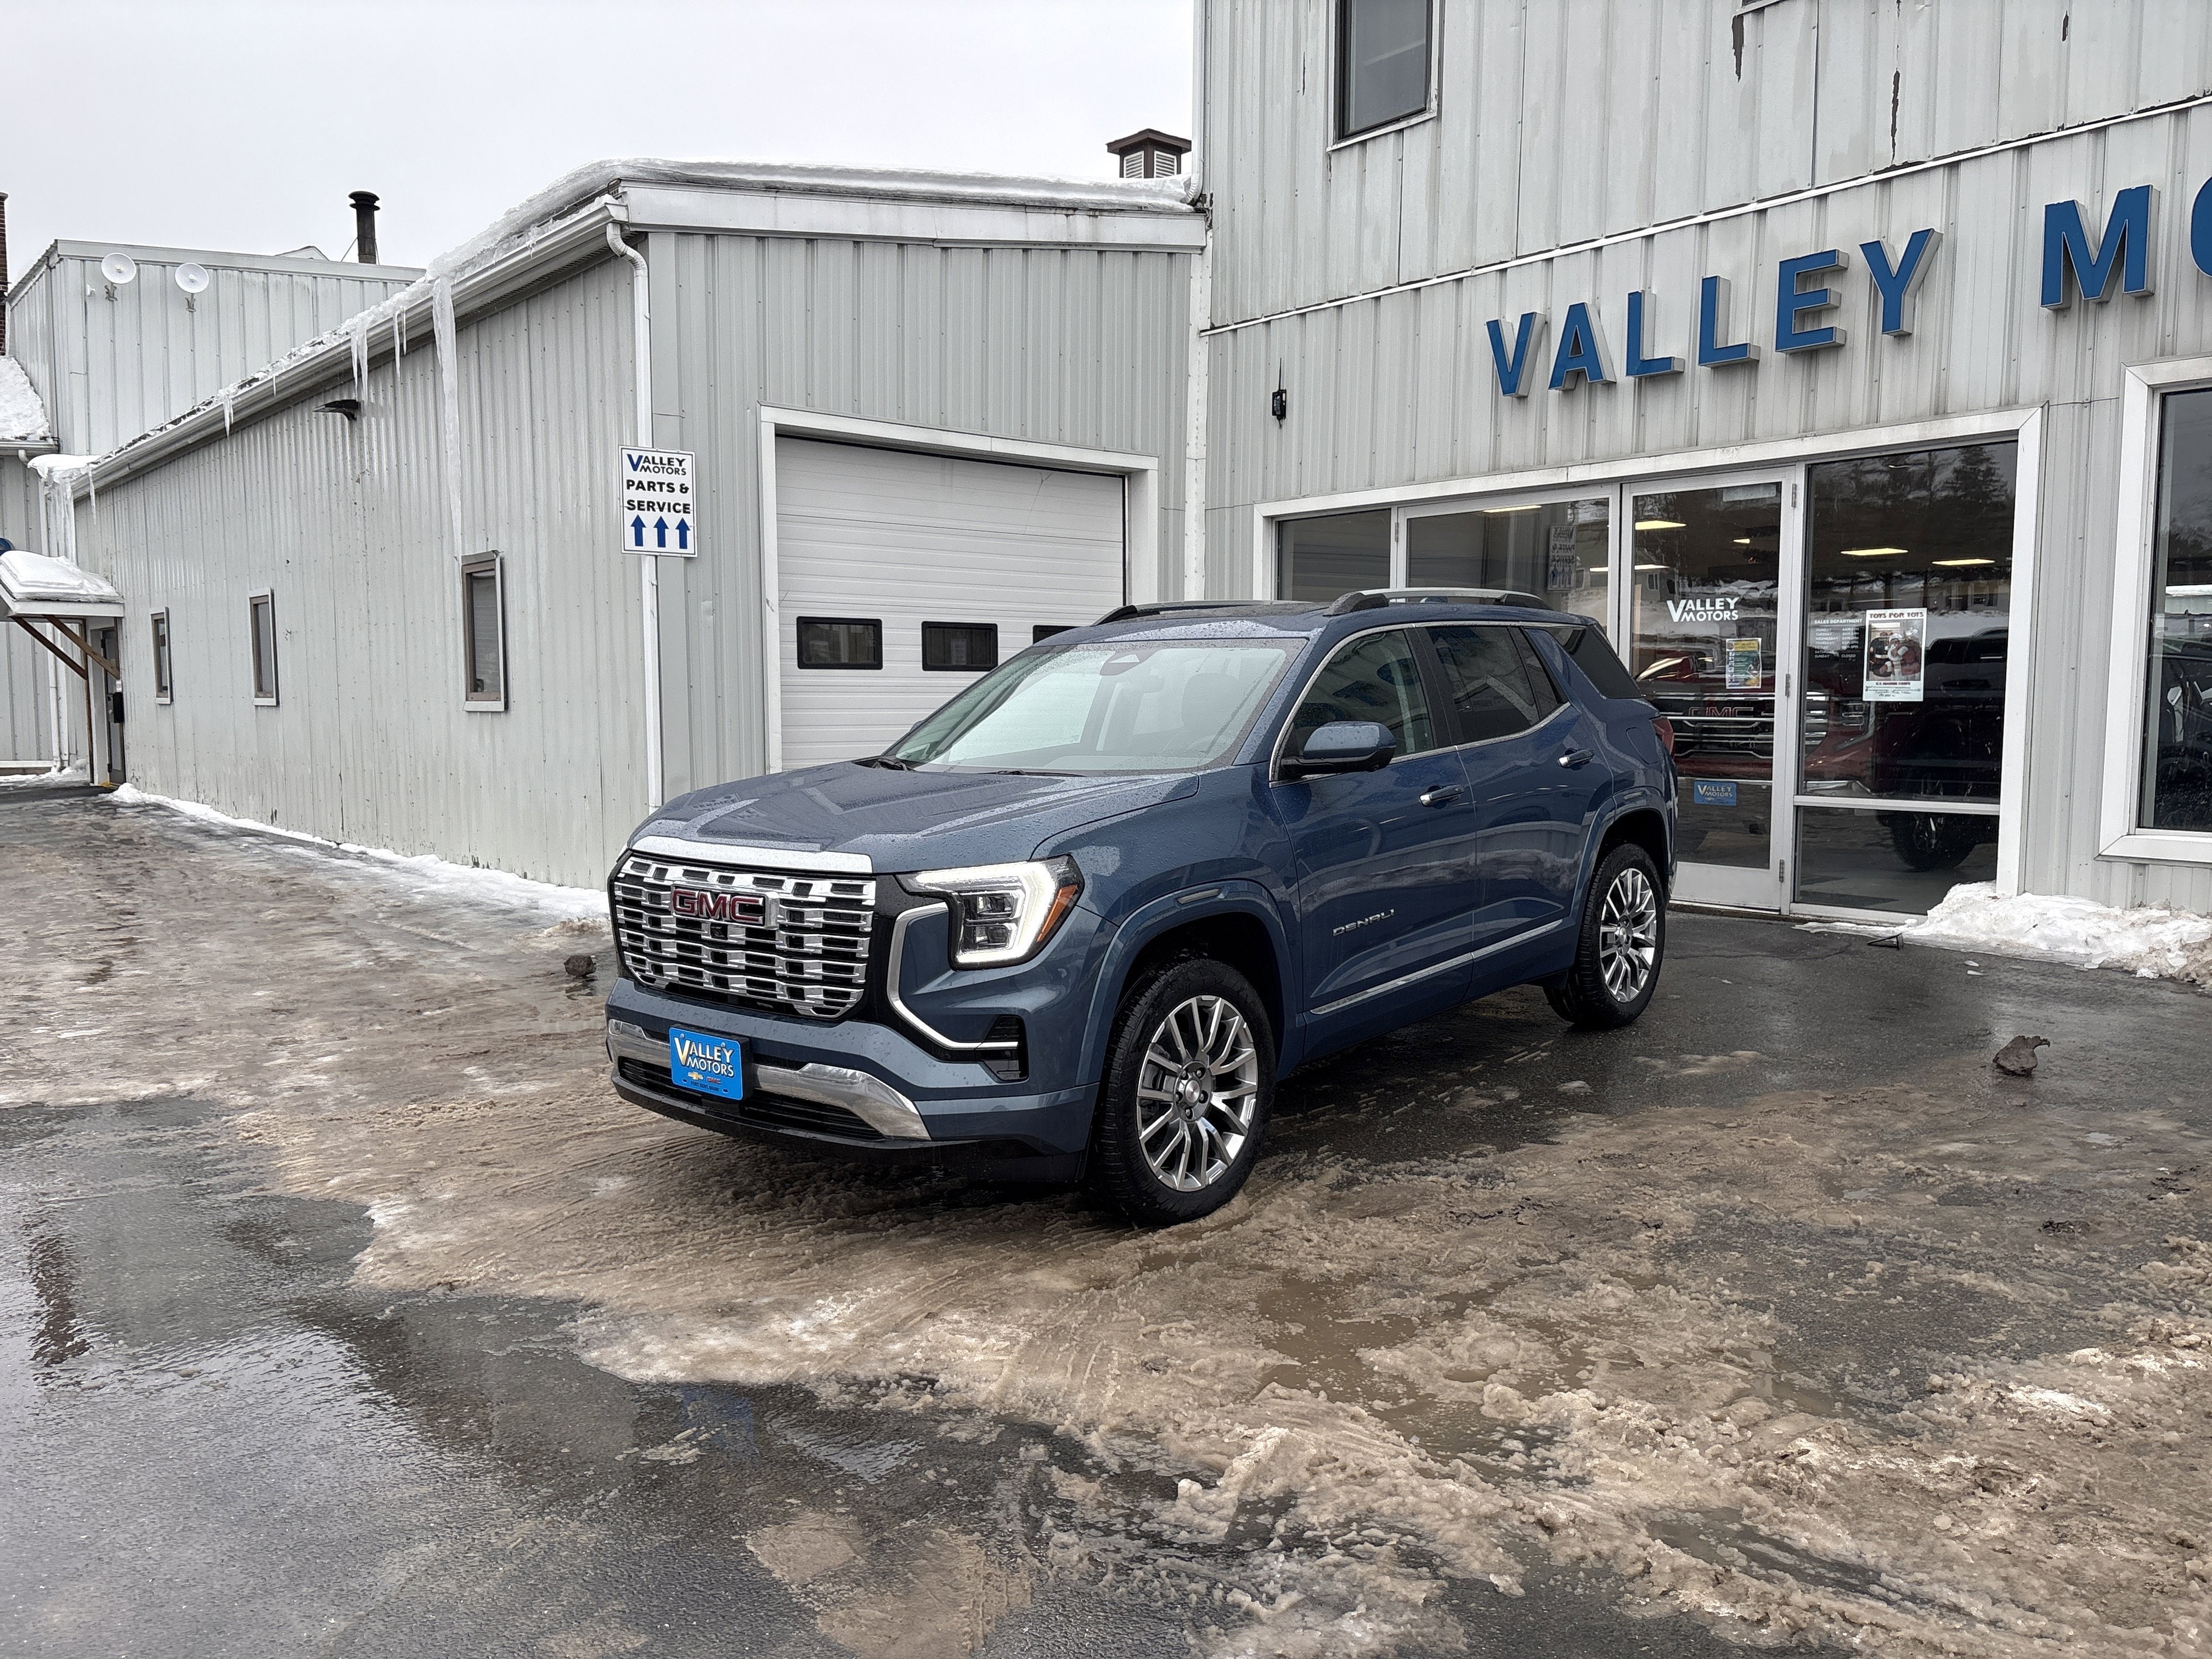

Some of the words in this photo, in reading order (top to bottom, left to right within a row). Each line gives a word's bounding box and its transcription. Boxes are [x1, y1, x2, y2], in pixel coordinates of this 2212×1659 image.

[1486, 228, 1942, 397] VALLEY
[2040, 176, 2212, 308] M
[627, 454, 686, 471] VALLEY
[639, 465, 686, 476] MOTORS
[626, 479, 675, 493] PARTS
[679, 483, 689, 494] &
[627, 499, 691, 514] SERVICE
[1666, 597, 1740, 622] VALLEY
[1680, 610, 1739, 622] MOTORS
[1689, 707, 1754, 717] GMC
[1697, 785, 1732, 795] VALLEY
[673, 888, 764, 924] GMC
[1333, 909, 1395, 937] DENALI
[674, 1037, 734, 1066] VALLEY
[687, 1056, 735, 1077] MOTORS
